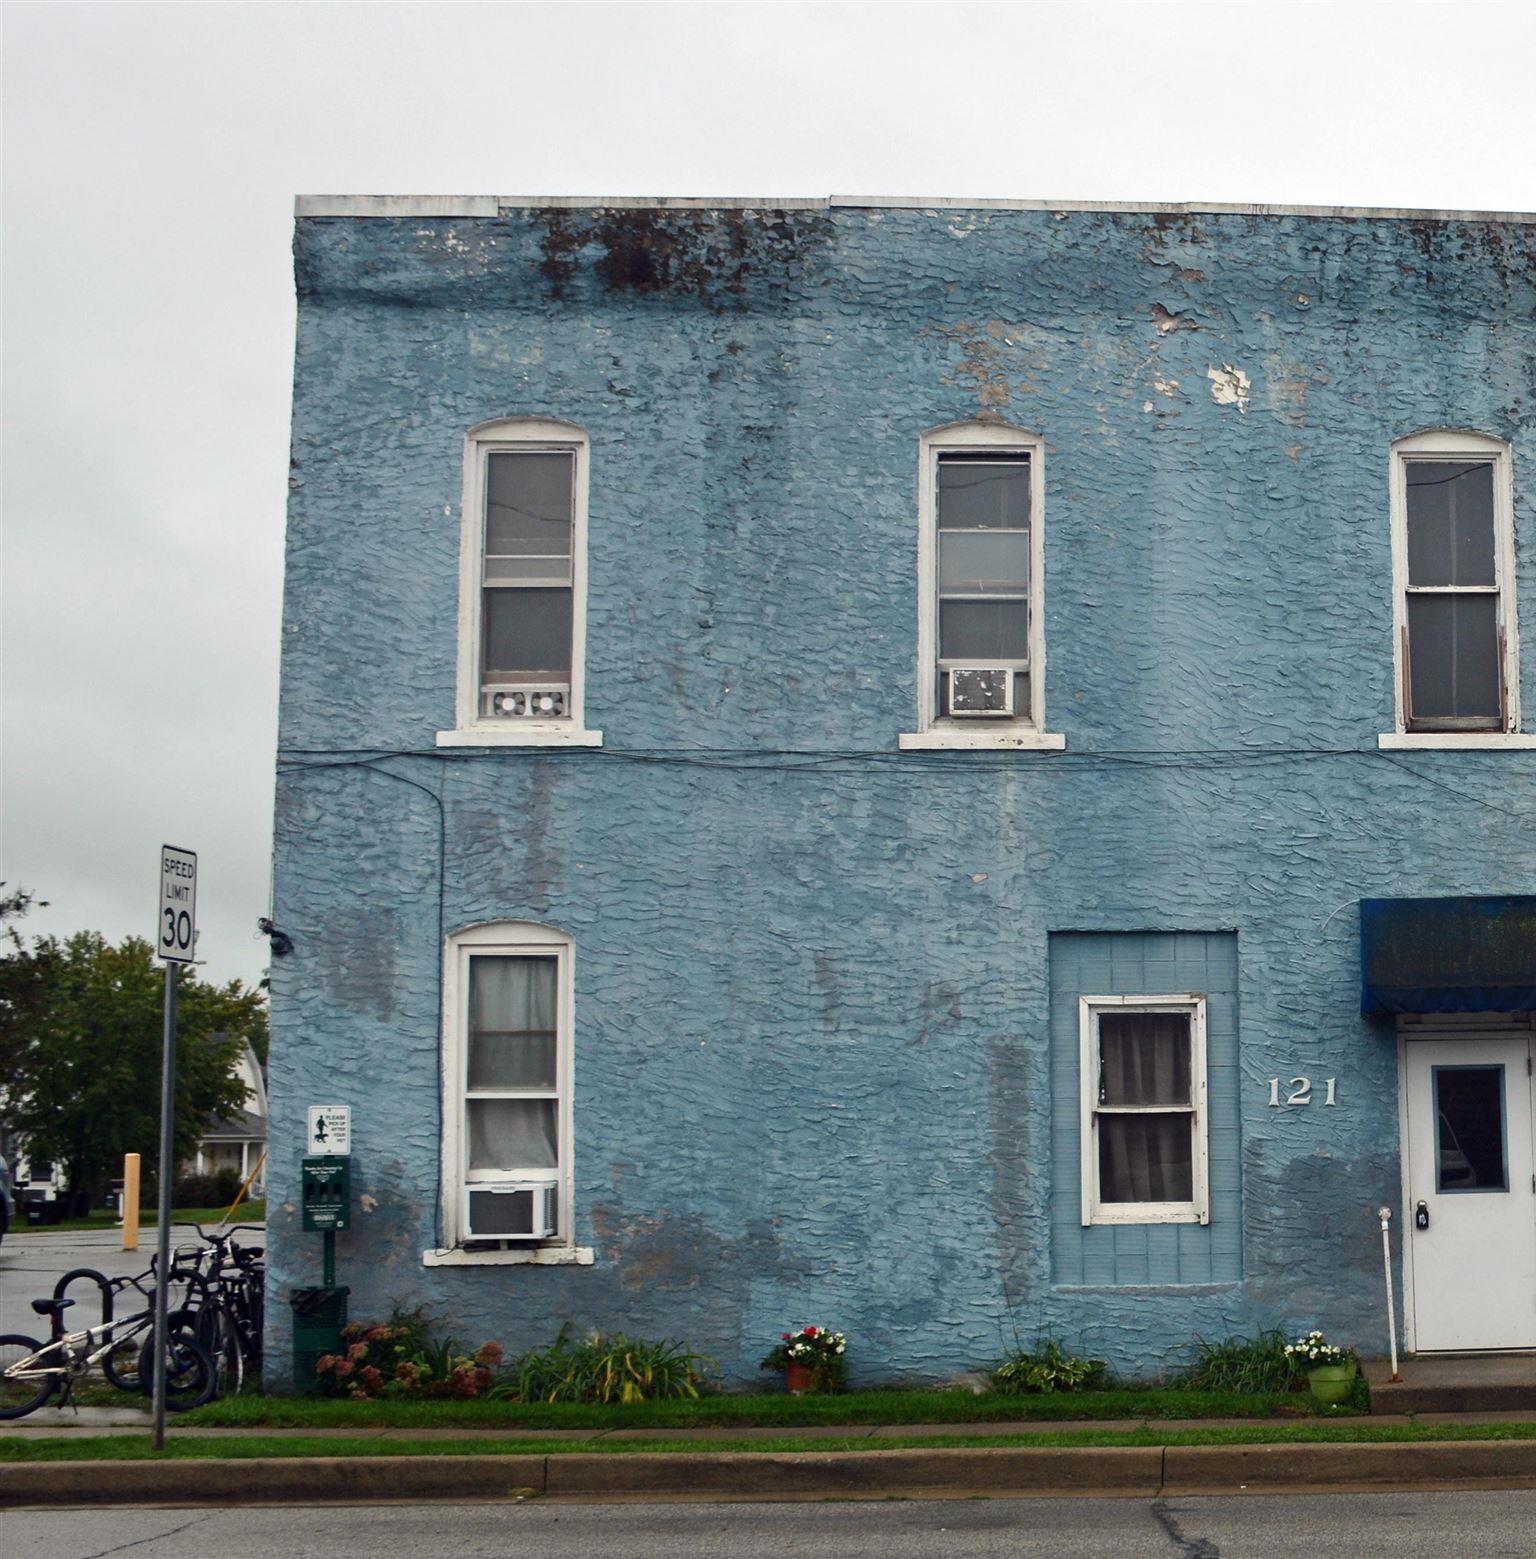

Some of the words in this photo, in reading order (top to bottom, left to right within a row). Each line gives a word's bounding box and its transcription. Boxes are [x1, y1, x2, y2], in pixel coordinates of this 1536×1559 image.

[165, 858, 194, 879] SPEED
[166, 883, 189, 901] LIMIT
[162, 907, 191, 950] 30
[1268, 1077, 1336, 1107] 121
